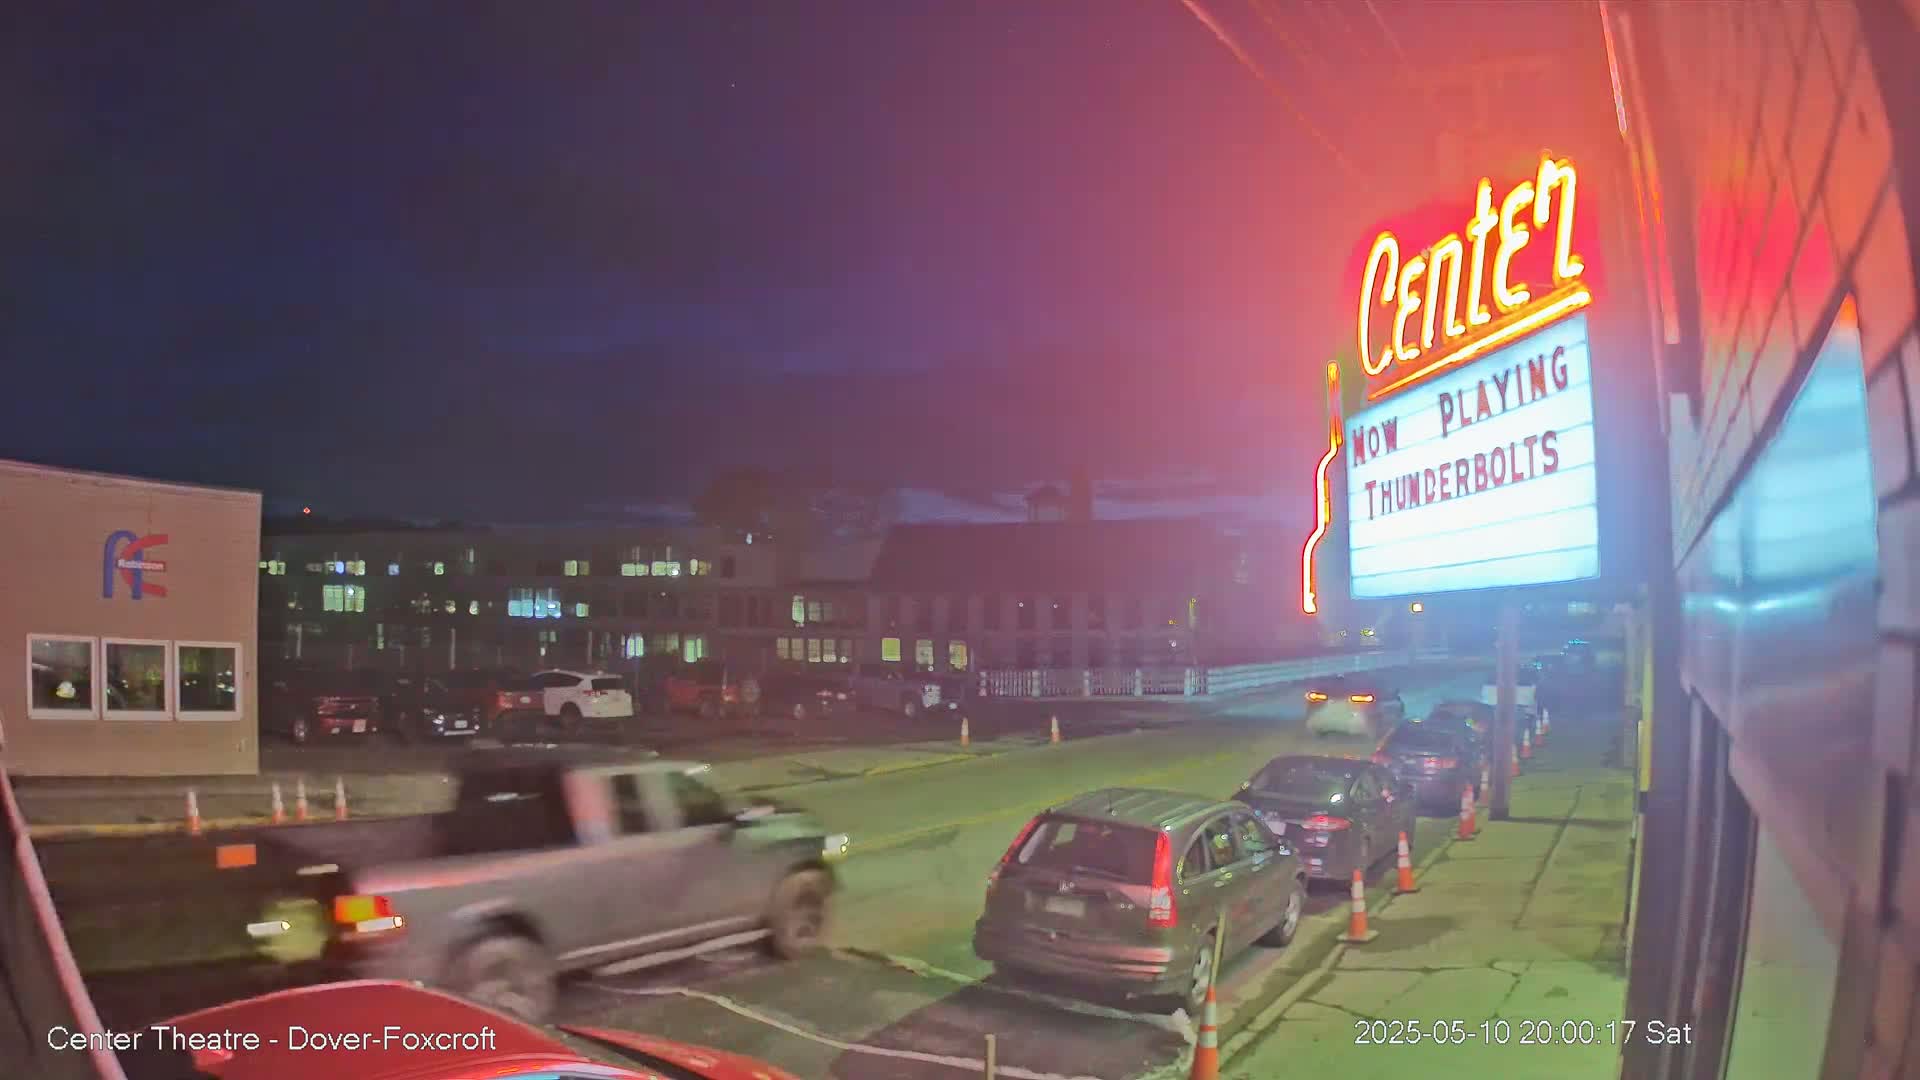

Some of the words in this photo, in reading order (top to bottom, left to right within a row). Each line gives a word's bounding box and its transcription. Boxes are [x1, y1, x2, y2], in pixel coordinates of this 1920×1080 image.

[1358, 152, 1585, 376] Center
[1353, 417, 1398, 467] NOW
[1439, 346, 1568, 437] PLAYING
[1365, 431, 1559, 520] THUNDERBOLTS
